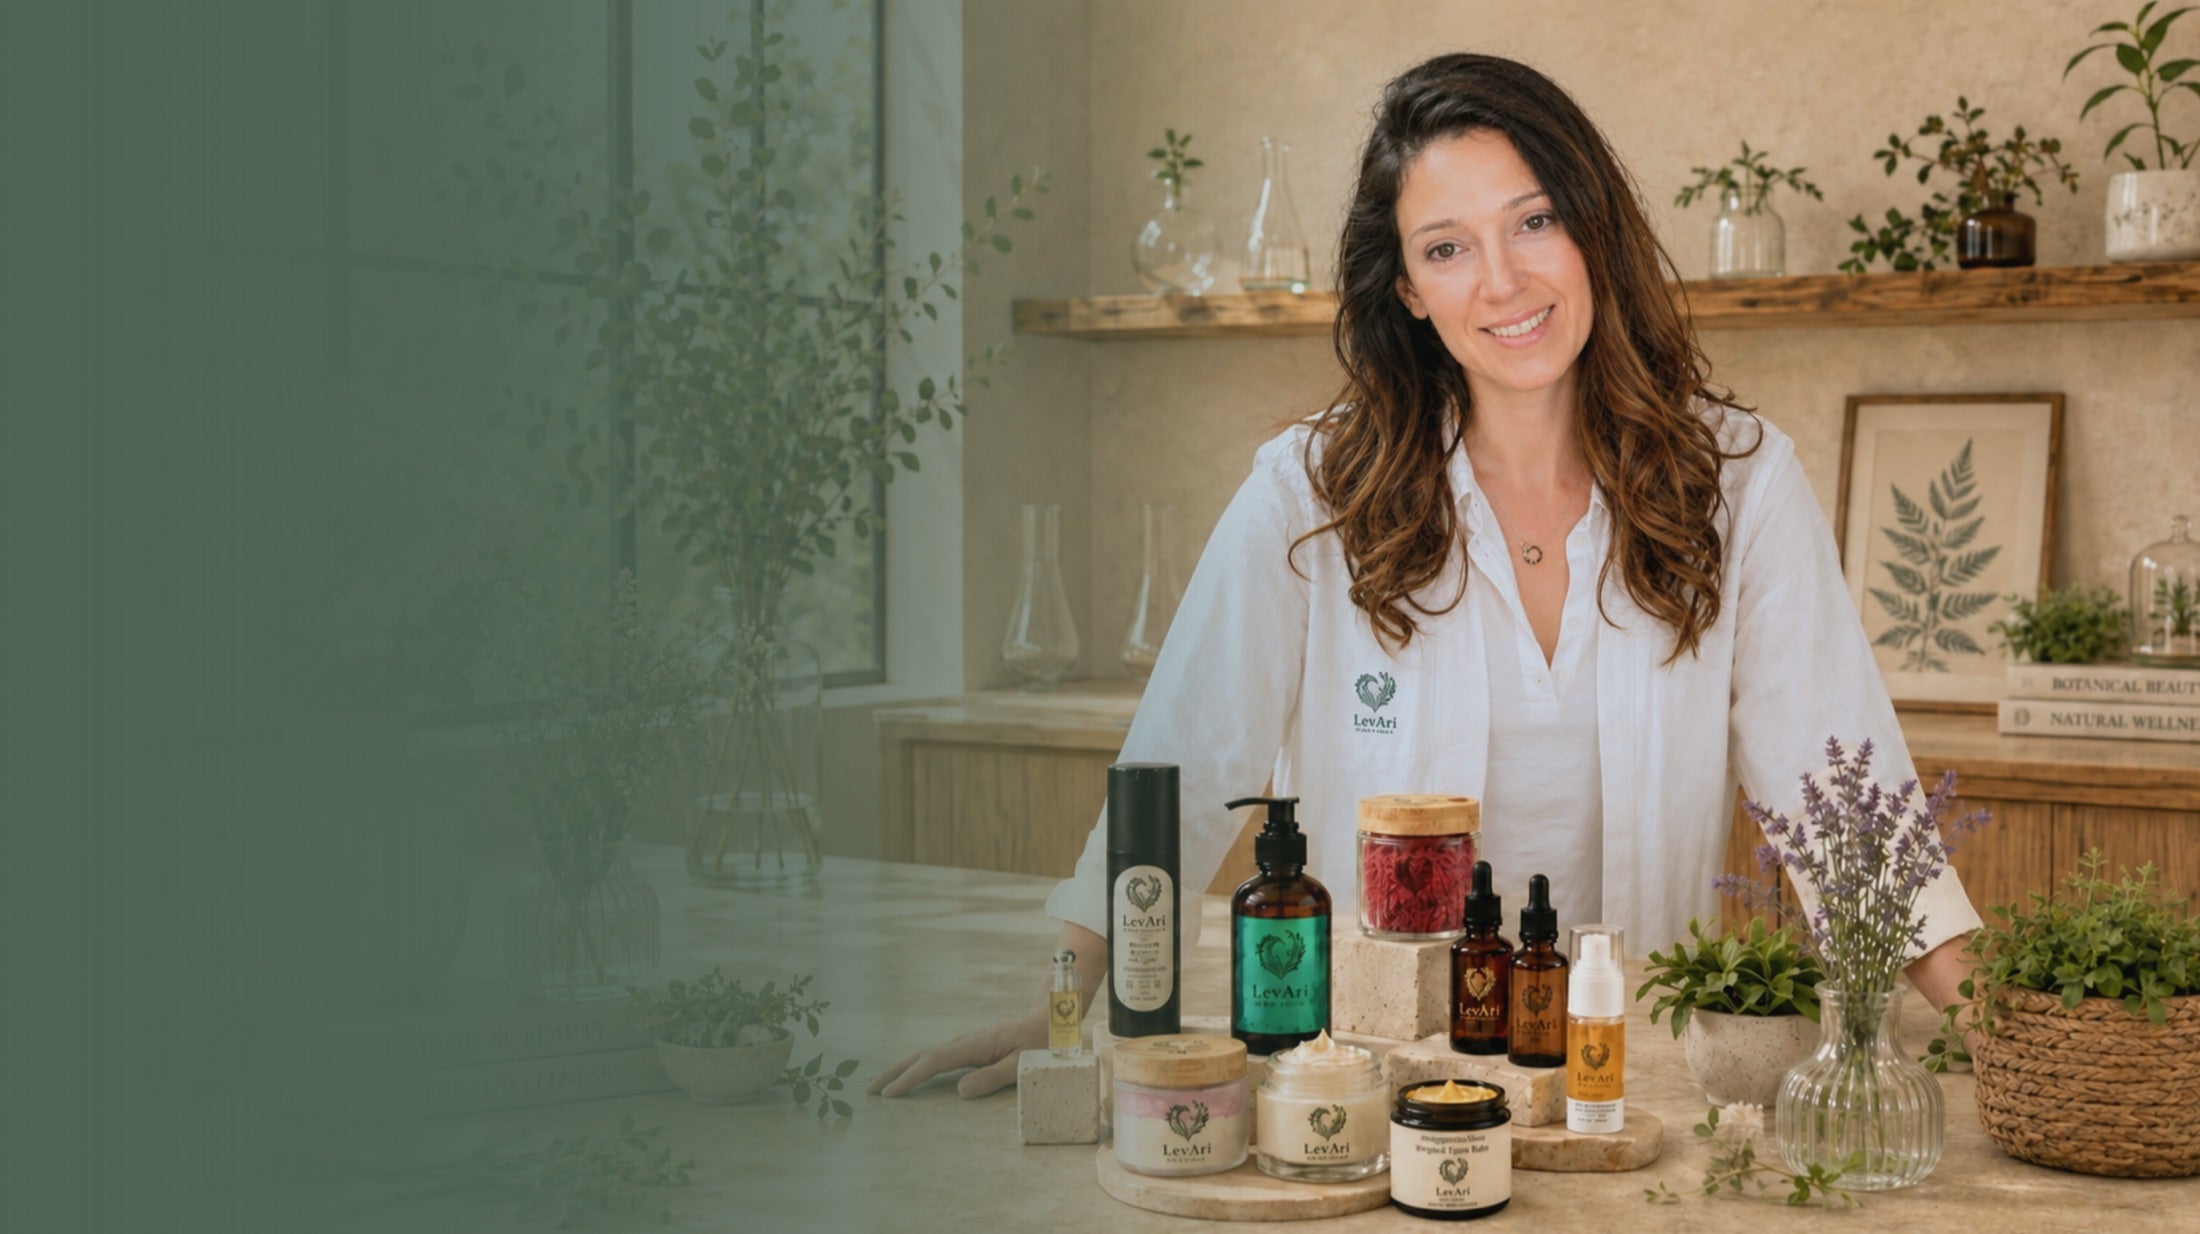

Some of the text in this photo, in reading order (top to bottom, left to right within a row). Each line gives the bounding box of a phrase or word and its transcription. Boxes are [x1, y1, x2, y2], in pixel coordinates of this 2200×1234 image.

[2052, 678, 2200, 695] BOTANICAL BEAUT
[1354, 713, 1397, 729] LevAri
[2051, 712, 2128, 728] NATURAL
[1123, 914, 1166, 928] LevAri
[1253, 984, 1308, 999] LevAri
[1459, 1002, 1500, 1017] LevAri
[1516, 1018, 1557, 1031] LevAri
[1577, 1071, 1614, 1083] LevAri
[1163, 1142, 1212, 1156] LevAri
[1303, 1142, 1350, 1156] LevAri
[1436, 1187, 1471, 1196] LevAri
